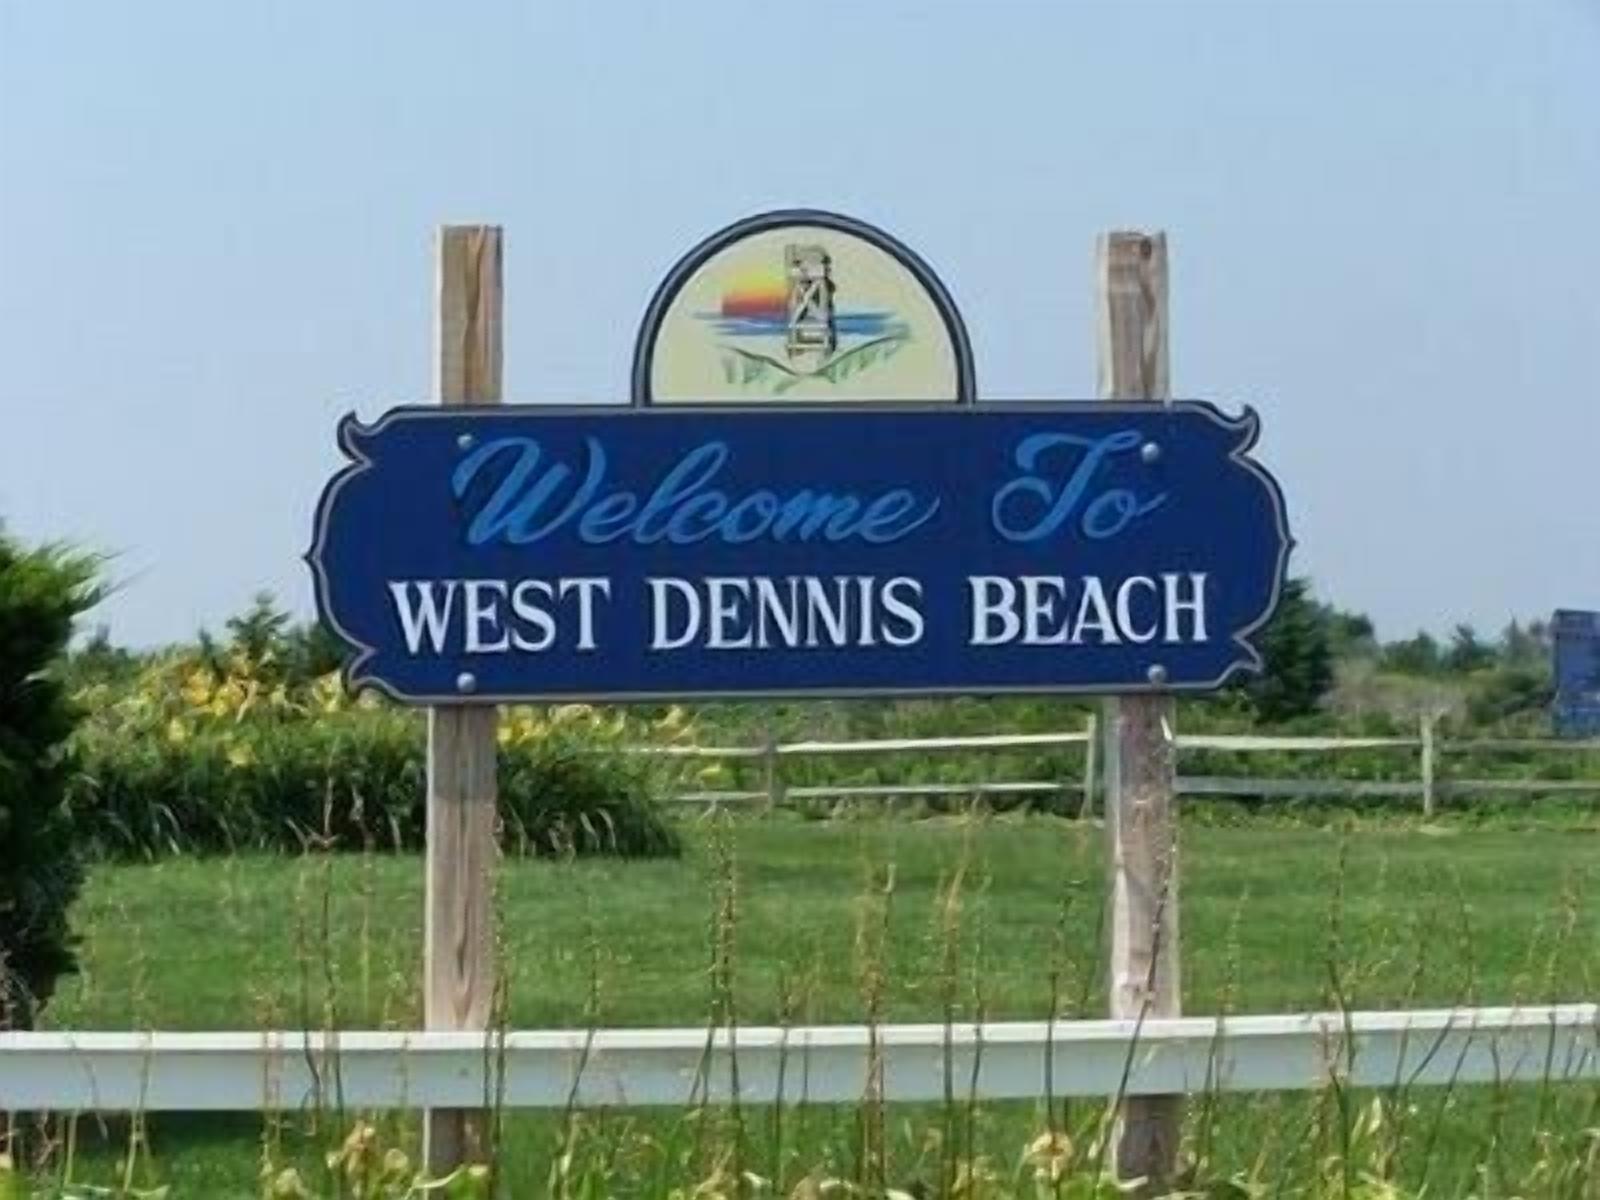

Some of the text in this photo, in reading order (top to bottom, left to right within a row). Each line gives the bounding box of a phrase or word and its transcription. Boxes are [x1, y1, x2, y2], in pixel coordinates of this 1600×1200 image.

[452, 430, 1168, 545] Welcome To
[388, 572, 1208, 654] WEST DENNIS BEACH
